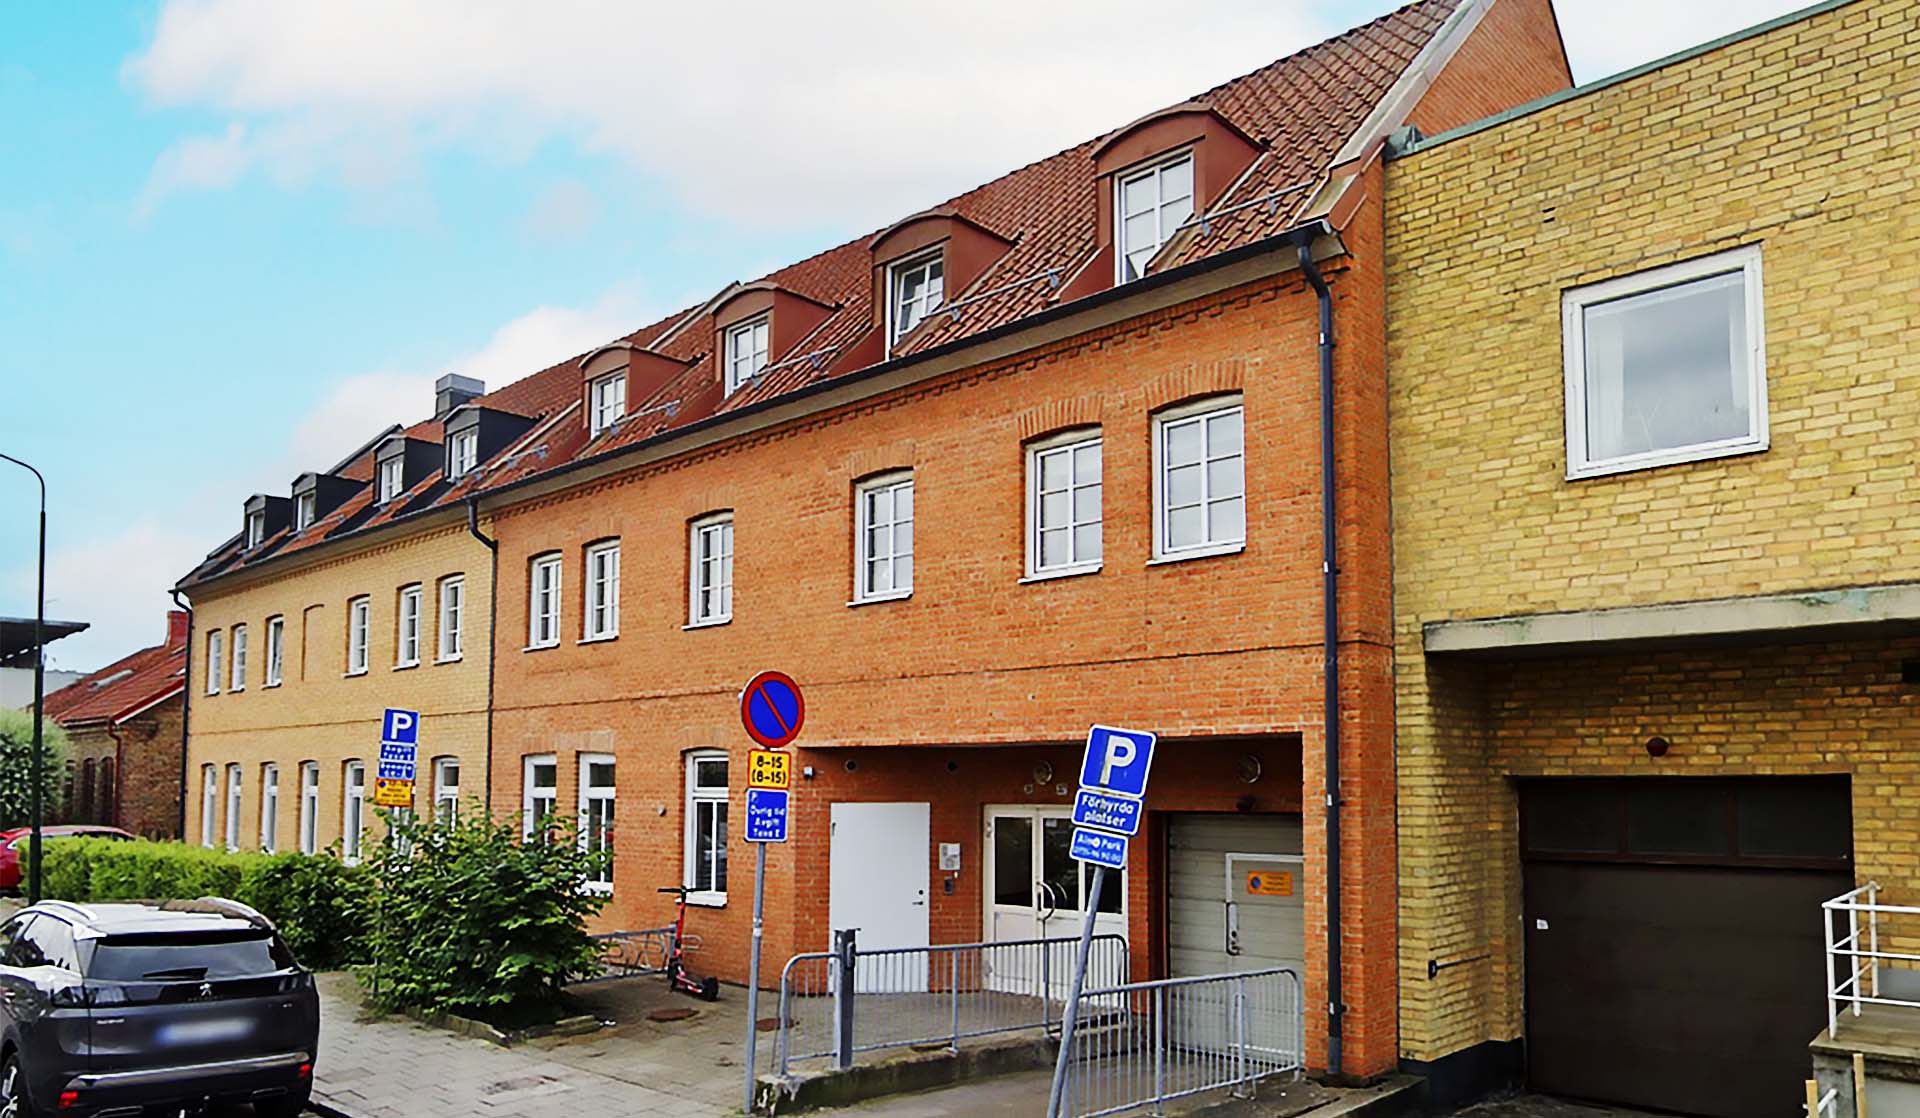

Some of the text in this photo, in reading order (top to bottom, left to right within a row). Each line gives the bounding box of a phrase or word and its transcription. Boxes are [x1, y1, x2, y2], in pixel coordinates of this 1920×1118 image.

[391, 712, 413, 740] P
[756, 755, 783, 769] 8-15
[1099, 735, 1136, 785] P
[752, 769, 786, 785] (8-15)
[1081, 795, 1134, 815] Förhyrda
[1084, 810, 1126, 827] platser
